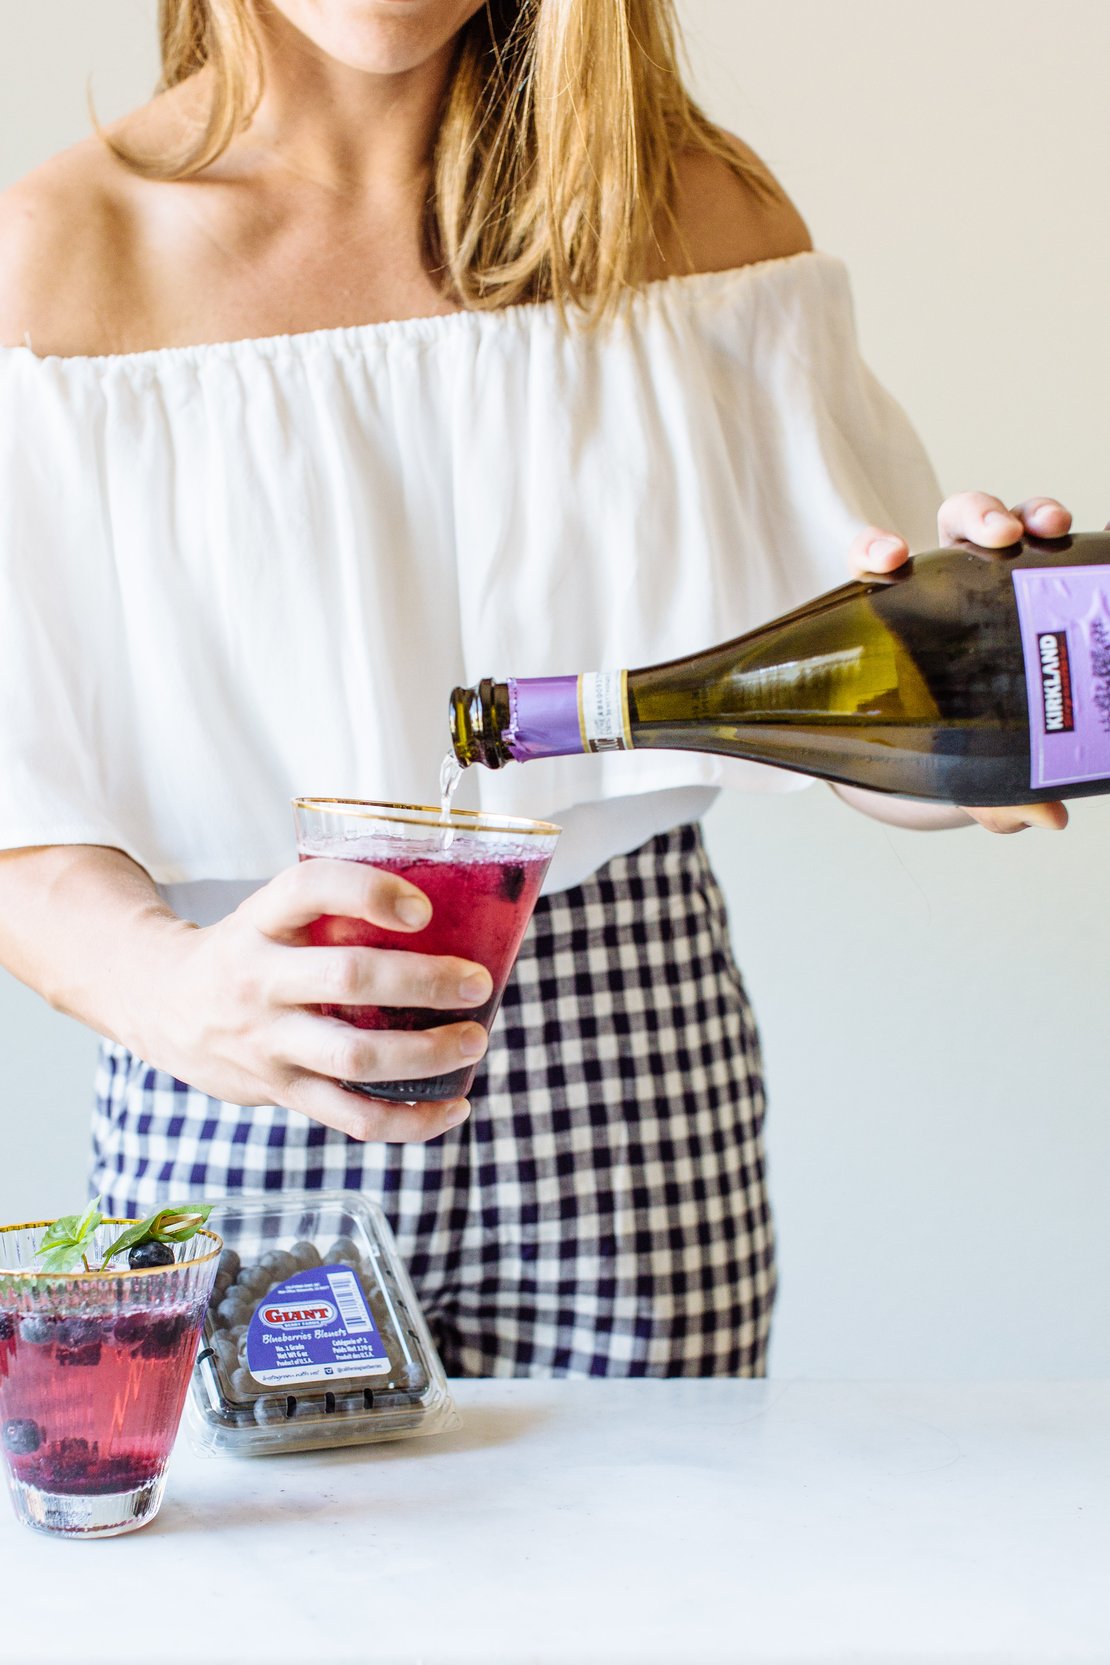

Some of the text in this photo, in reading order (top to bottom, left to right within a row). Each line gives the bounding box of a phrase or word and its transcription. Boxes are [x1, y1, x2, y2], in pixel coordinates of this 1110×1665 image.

[1040, 634, 1063, 730] KIRKLAND
[265, 1308, 328, 1323] GIANT
[262, 1328, 347, 1344] Blueberries Bleuets
